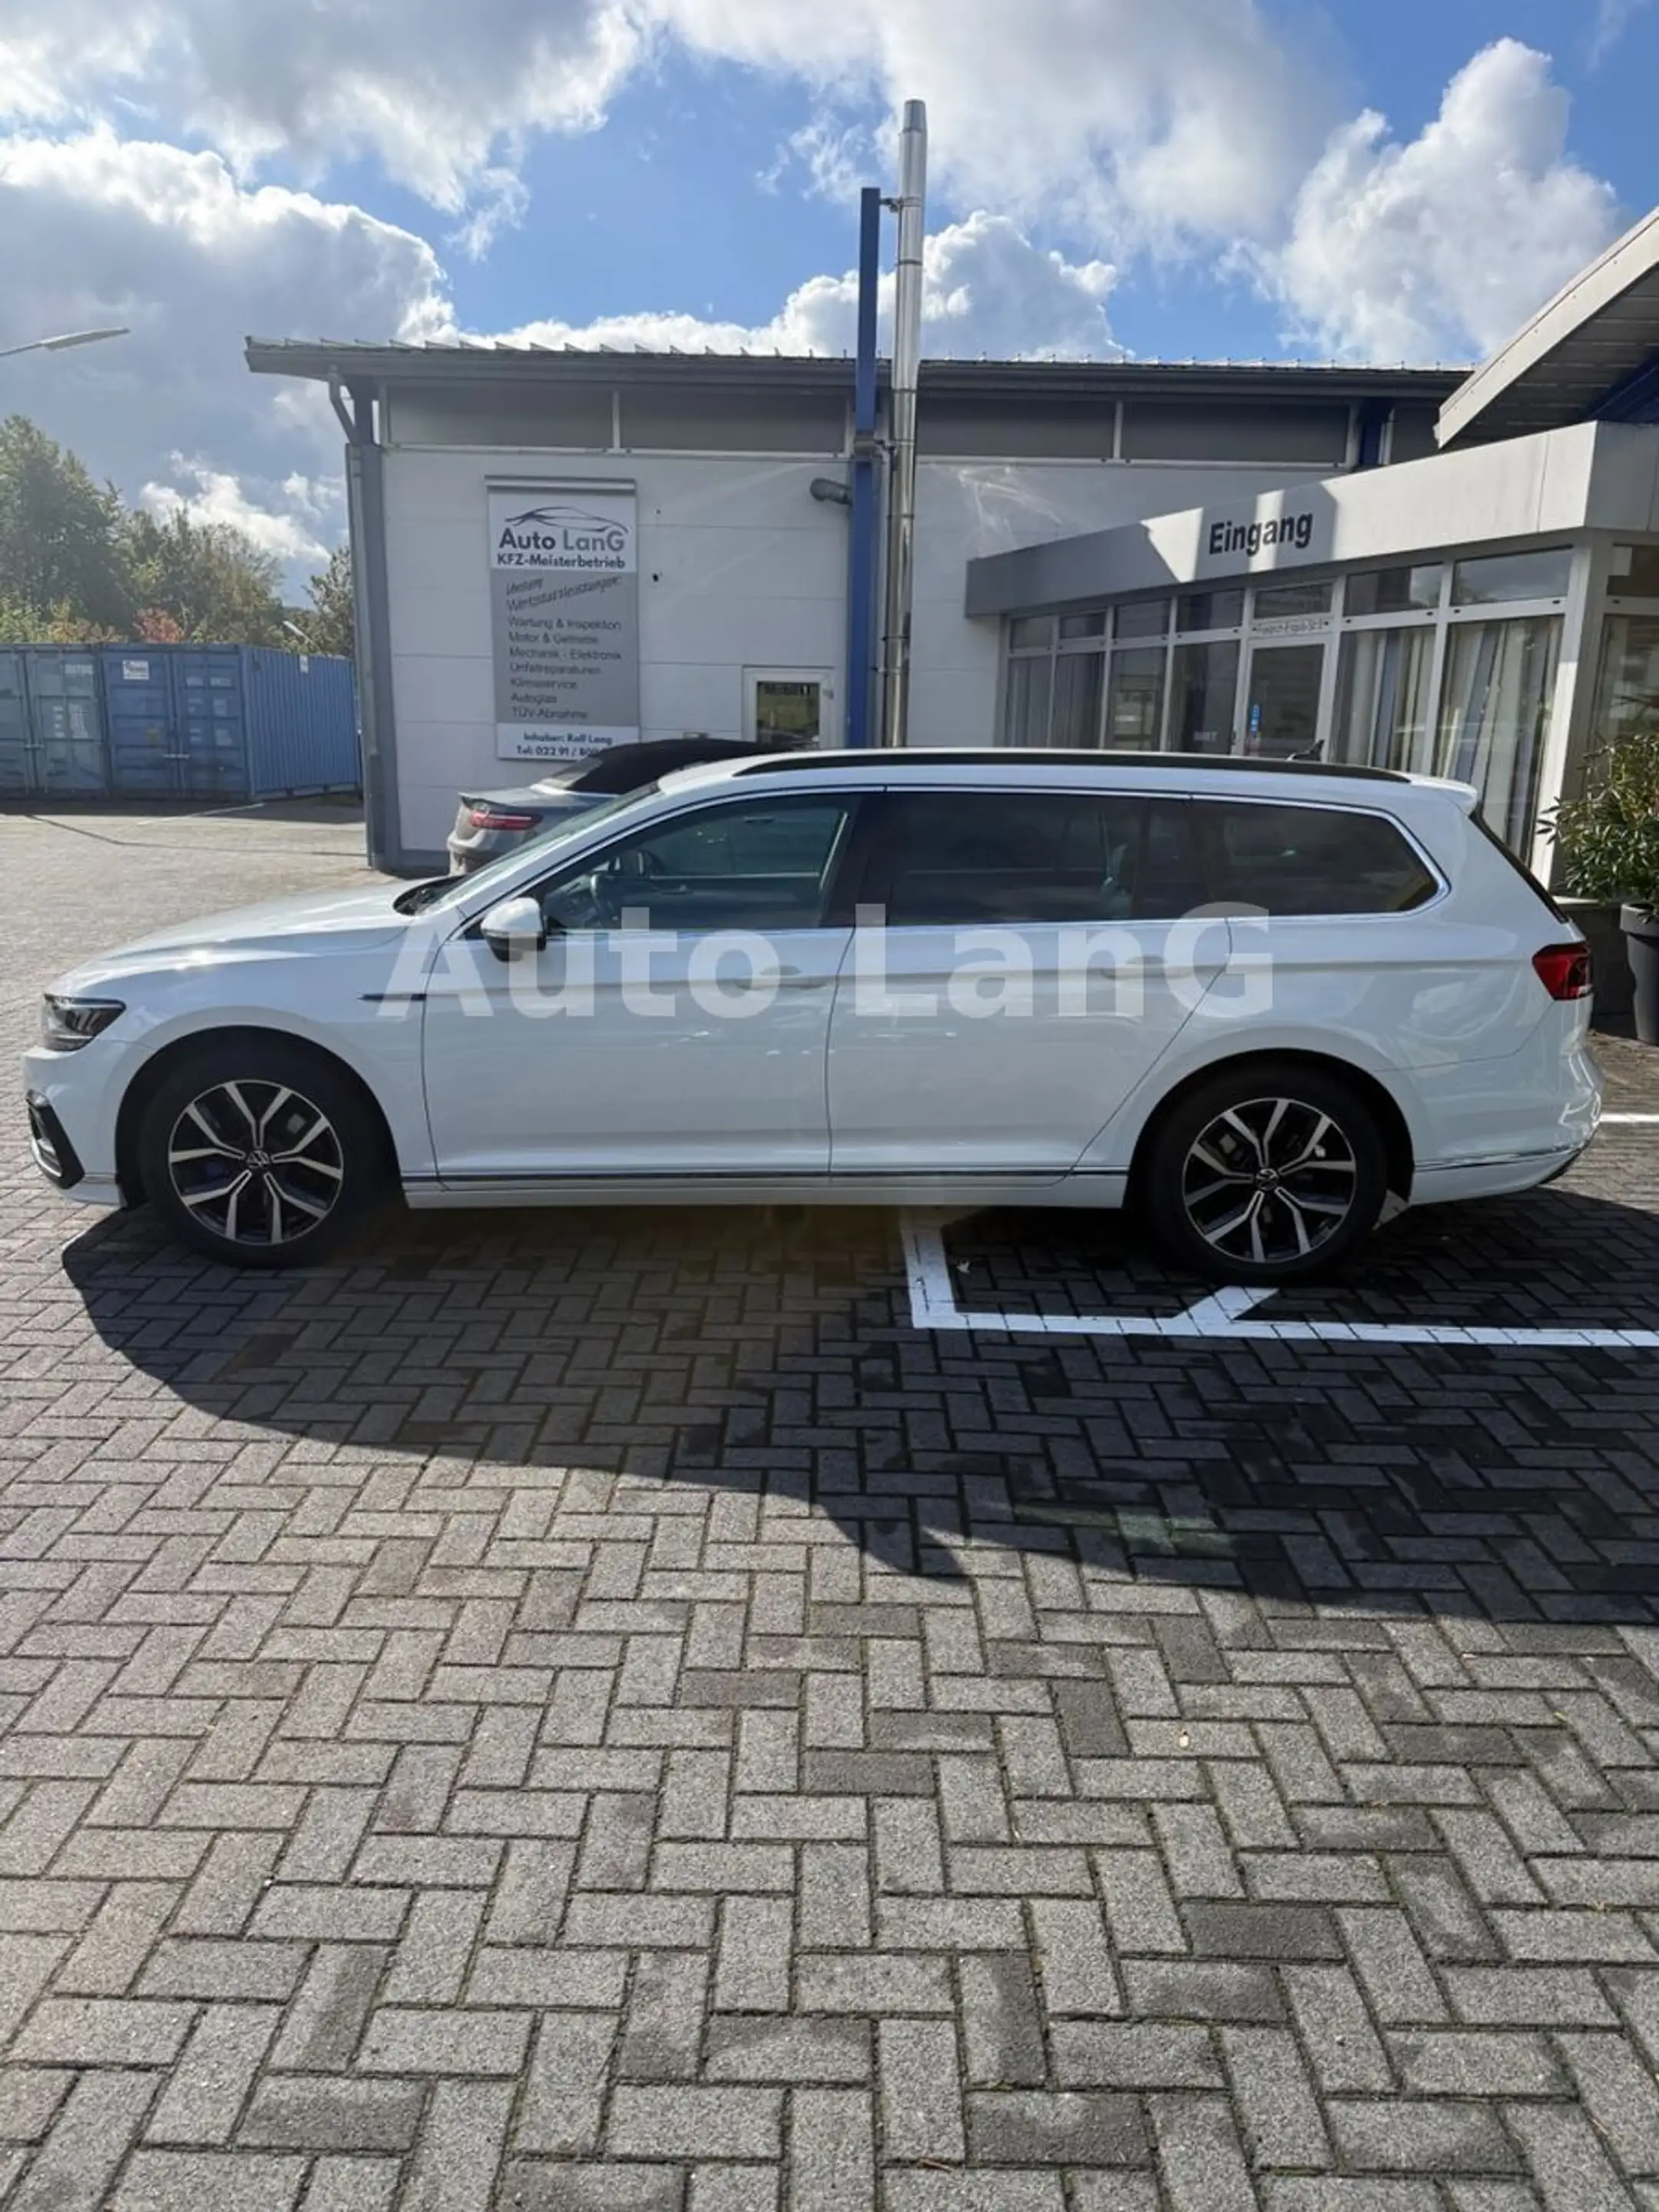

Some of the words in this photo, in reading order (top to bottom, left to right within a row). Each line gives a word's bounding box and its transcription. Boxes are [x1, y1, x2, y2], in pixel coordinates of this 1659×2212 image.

[499, 527, 556, 551] Auto
[563, 528, 625, 552] LanG
[1209, 513, 1313, 558] Eingang
[497, 552, 626, 569] KFZ-Meisterbetrieb
[508, 631, 539, 642] Motor
